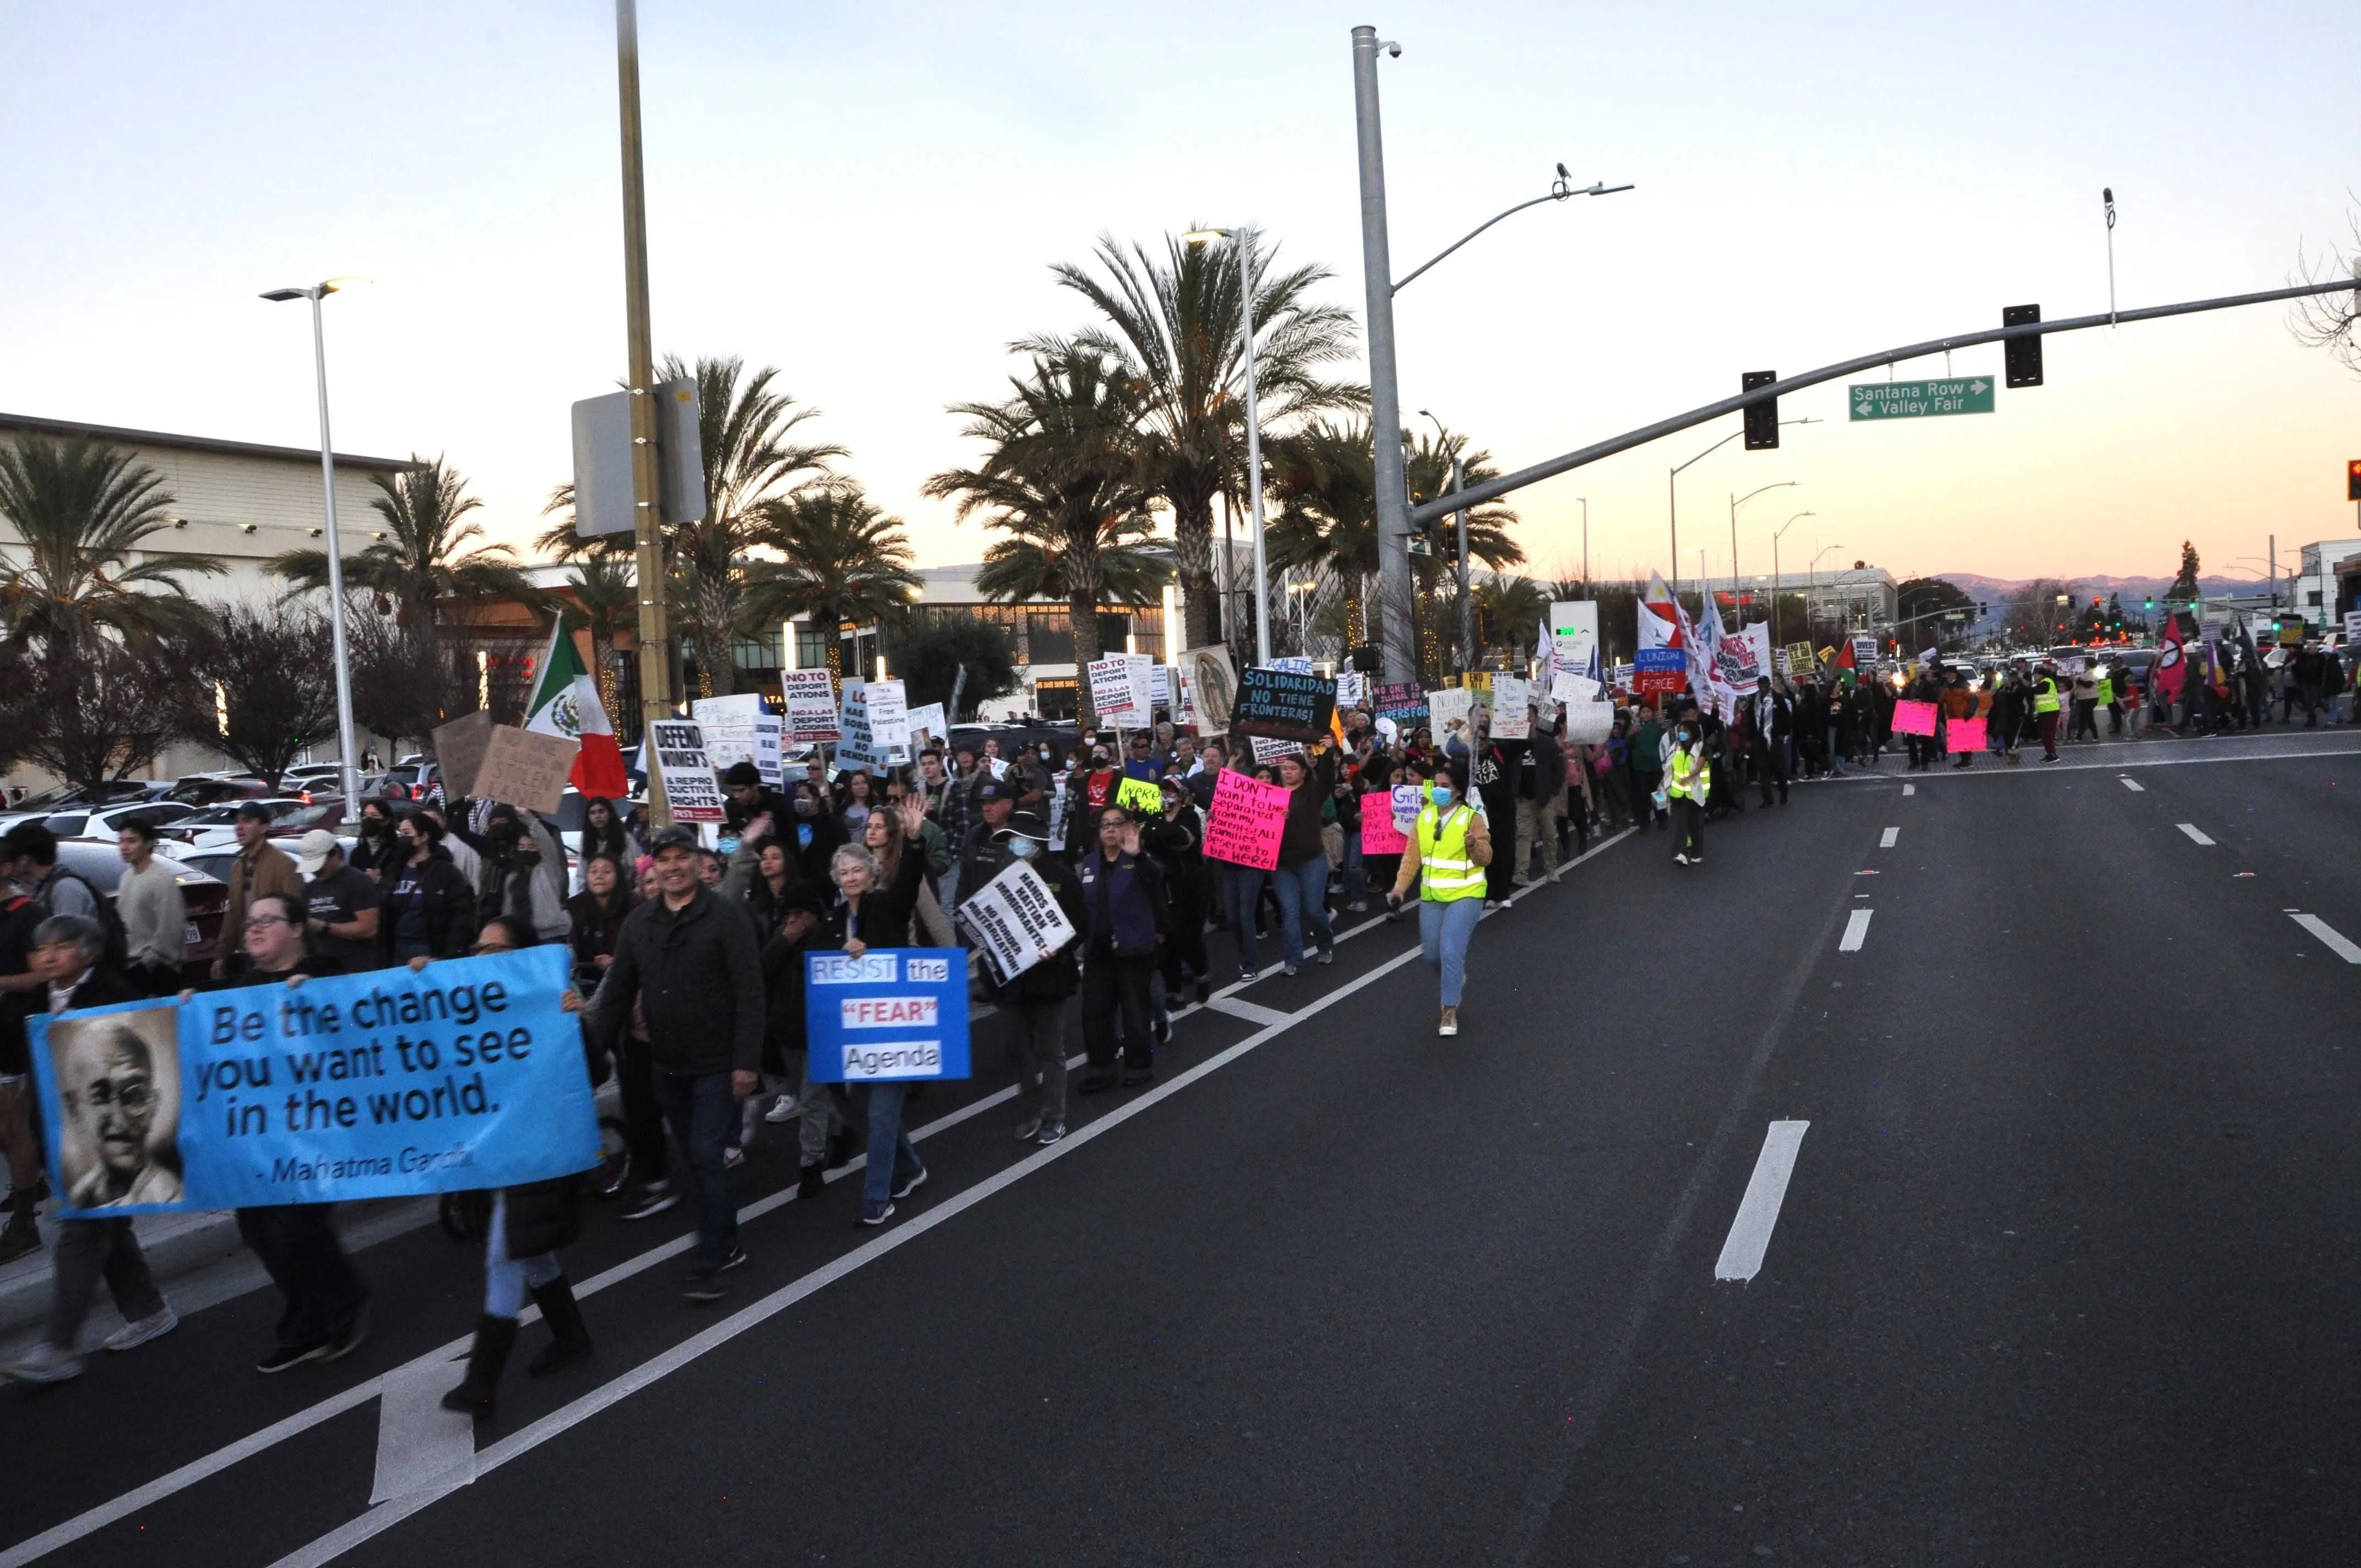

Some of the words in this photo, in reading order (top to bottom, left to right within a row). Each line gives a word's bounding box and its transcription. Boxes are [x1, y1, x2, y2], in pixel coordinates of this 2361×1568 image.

[1855, 385, 1920, 401] Santana
[1928, 383, 1964, 396] Row
[1880, 400, 1928, 415] Valley
[1934, 396, 1964, 411] Fair
[1090, 662, 1108, 671] NO
[1109, 659, 1125, 667] TO
[1091, 667, 1126, 677] DEPORT
[786, 673, 806, 682] NO
[808, 672, 825, 681] TO
[1092, 674, 1127, 685] ATIONS
[1243, 671, 1335, 695] SOLIDARIDAD
[1470, 673, 1483, 682] END
[1642, 678, 1674, 691] FORCE
[1095, 691, 1131, 702] DEPORT
[1389, 684, 1405, 694] ONE
[1411, 683, 1420, 691] IS
[1096, 696, 1132, 707] ACIONES
[1251, 690, 1271, 703] NO
[1279, 693, 1315, 706] TIENE
[1437, 695, 1450, 708] NO
[845, 706, 864, 717] HAS
[1240, 703, 1314, 723] FRONTERAS!
[1411, 705, 1429, 716] FOR
[853, 732, 873, 742] AND
[855, 742, 868, 752] NO
[1256, 741, 1297, 752] DEPORT
[1258, 747, 1299, 758] ACIONES
[840, 749, 877, 764] GENDER
[1219, 771, 1229, 785] I
[1234, 777, 1272, 798] DON'T
[670, 796, 718, 805] RIGHTS
[1363, 793, 1389, 807] OLD
[1392, 785, 1423, 803] Girls
[1213, 799, 1273, 820] separated
[1251, 796, 1265, 809] to
[1268, 802, 1283, 812] be
[1213, 808, 1237, 819] from
[1239, 814, 1254, 826] my
[1209, 826, 1257, 843] Families
[1211, 816, 1257, 836] Parents!
[1258, 829, 1277, 840] ALL
[1207, 835, 1250, 852] Deserve
[1256, 846, 1268, 856] to
[1364, 832, 1385, 843] OVER
[1015, 887, 1047, 929] HAITIAN
[1019, 873, 1048, 908] HANDS
[1046, 909, 1062, 928] OFF
[995, 882, 1047, 950] IMMIGRANTS!
[983, 905, 997, 919] NO
[995, 918, 1022, 955] BORDER
[812, 959, 896, 979] RESIST
[909, 960, 947, 979] the
[212, 1006, 264, 1045] Be
[281, 995, 340, 1038] the
[351, 980, 508, 1025] change
[195, 1055, 272, 1102] you
[288, 1038, 384, 1084] want
[396, 1035, 438, 1071] to
[455, 1026, 532, 1066] see
[845, 1044, 938, 1075] Agenda
[226, 1096, 265, 1136] in
[285, 1090, 356, 1131] the
[367, 1072, 499, 1125] world.
[271, 1155, 391, 1183] Mahatma
